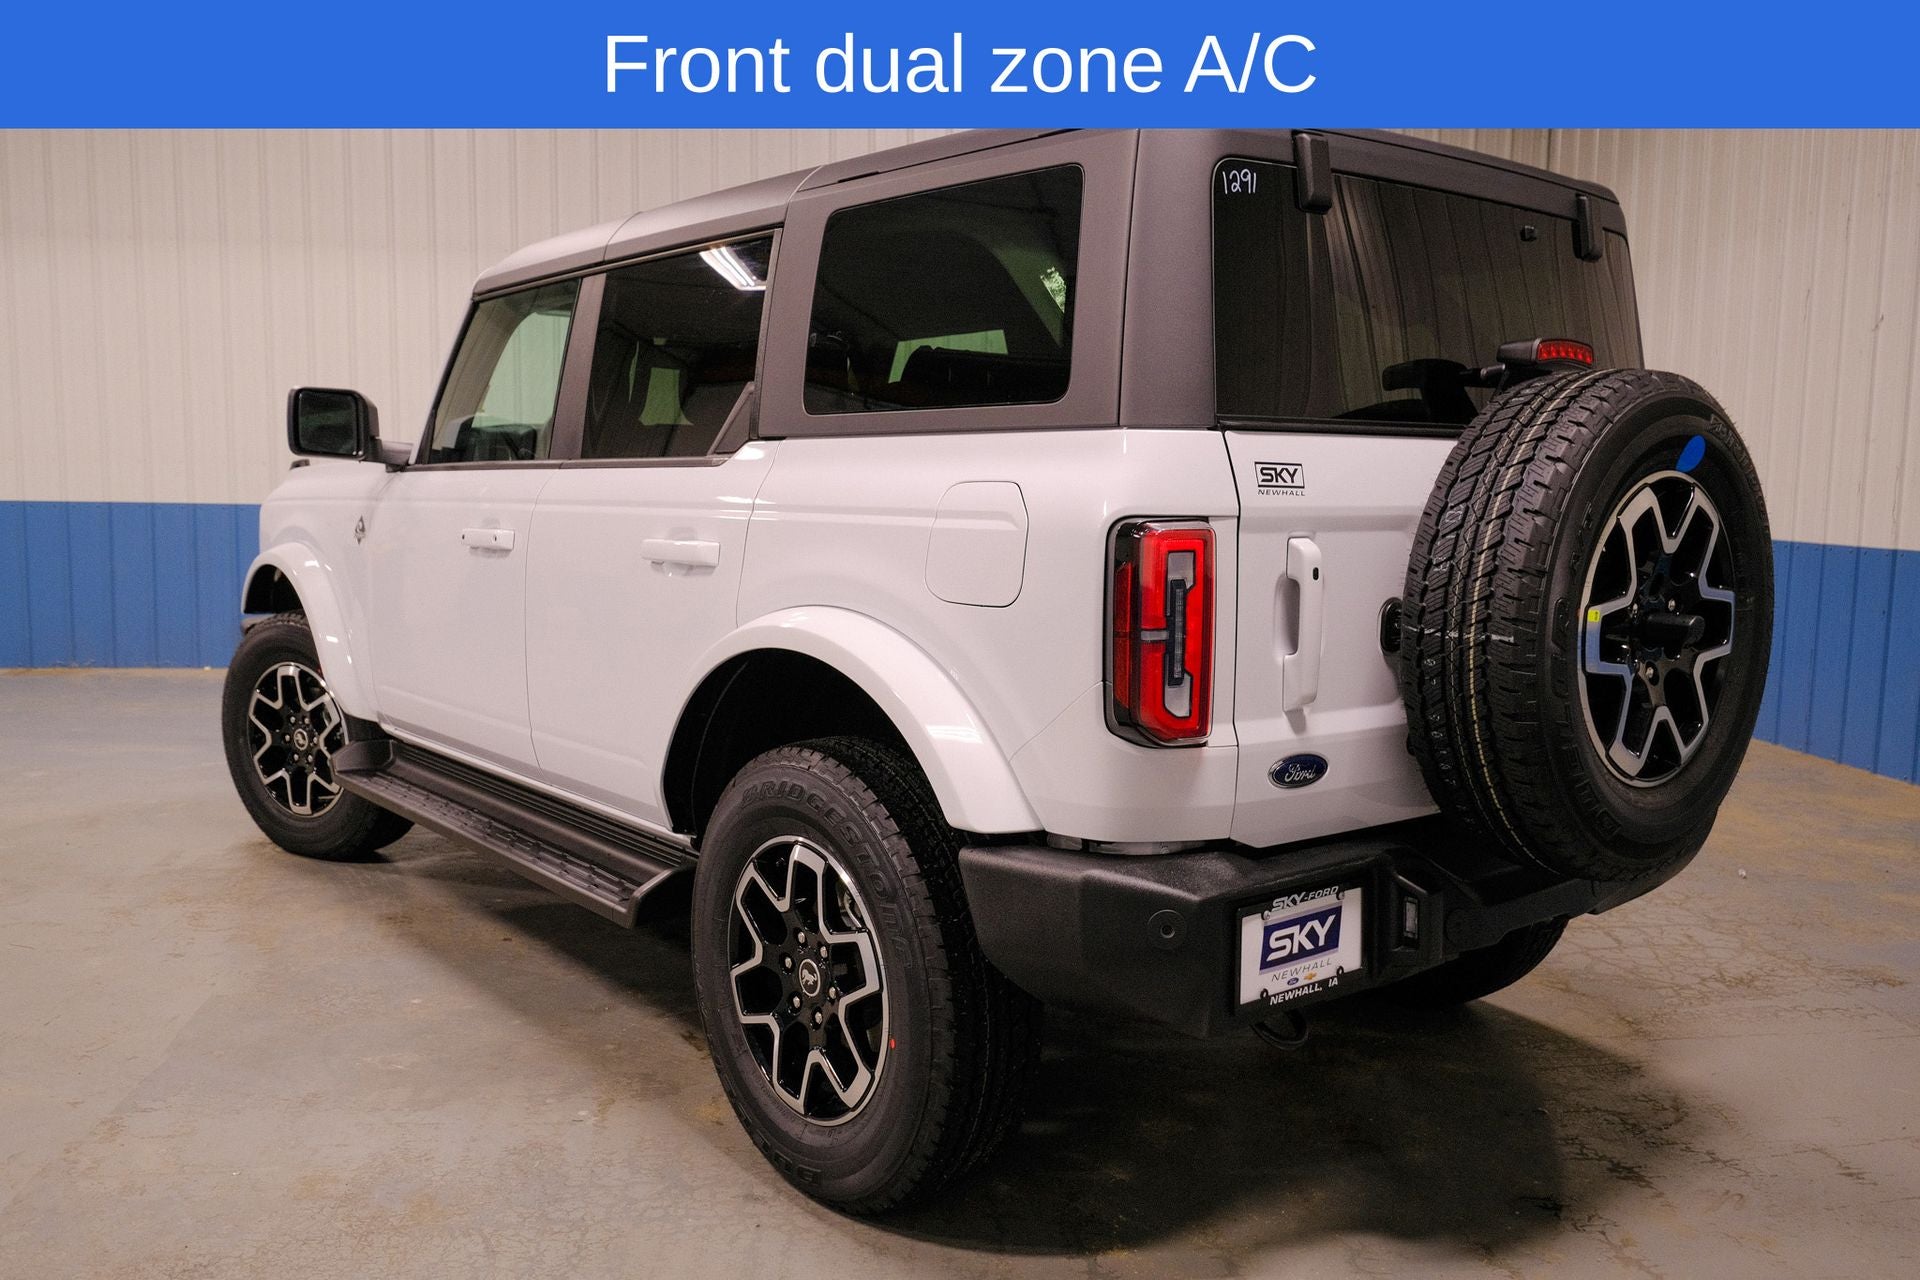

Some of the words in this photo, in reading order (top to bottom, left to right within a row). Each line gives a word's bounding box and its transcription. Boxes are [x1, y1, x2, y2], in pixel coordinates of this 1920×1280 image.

[1222, 168, 1257, 195] 1291
[1259, 466, 1299, 484] SKY
[1257, 489, 1306, 497] NEWHALL
[1284, 763, 1317, 783] Ford
[1266, 914, 1336, 962] SKY
[1271, 958, 1332, 982] NEWHALL
[1328, 977, 1339, 988] IA
